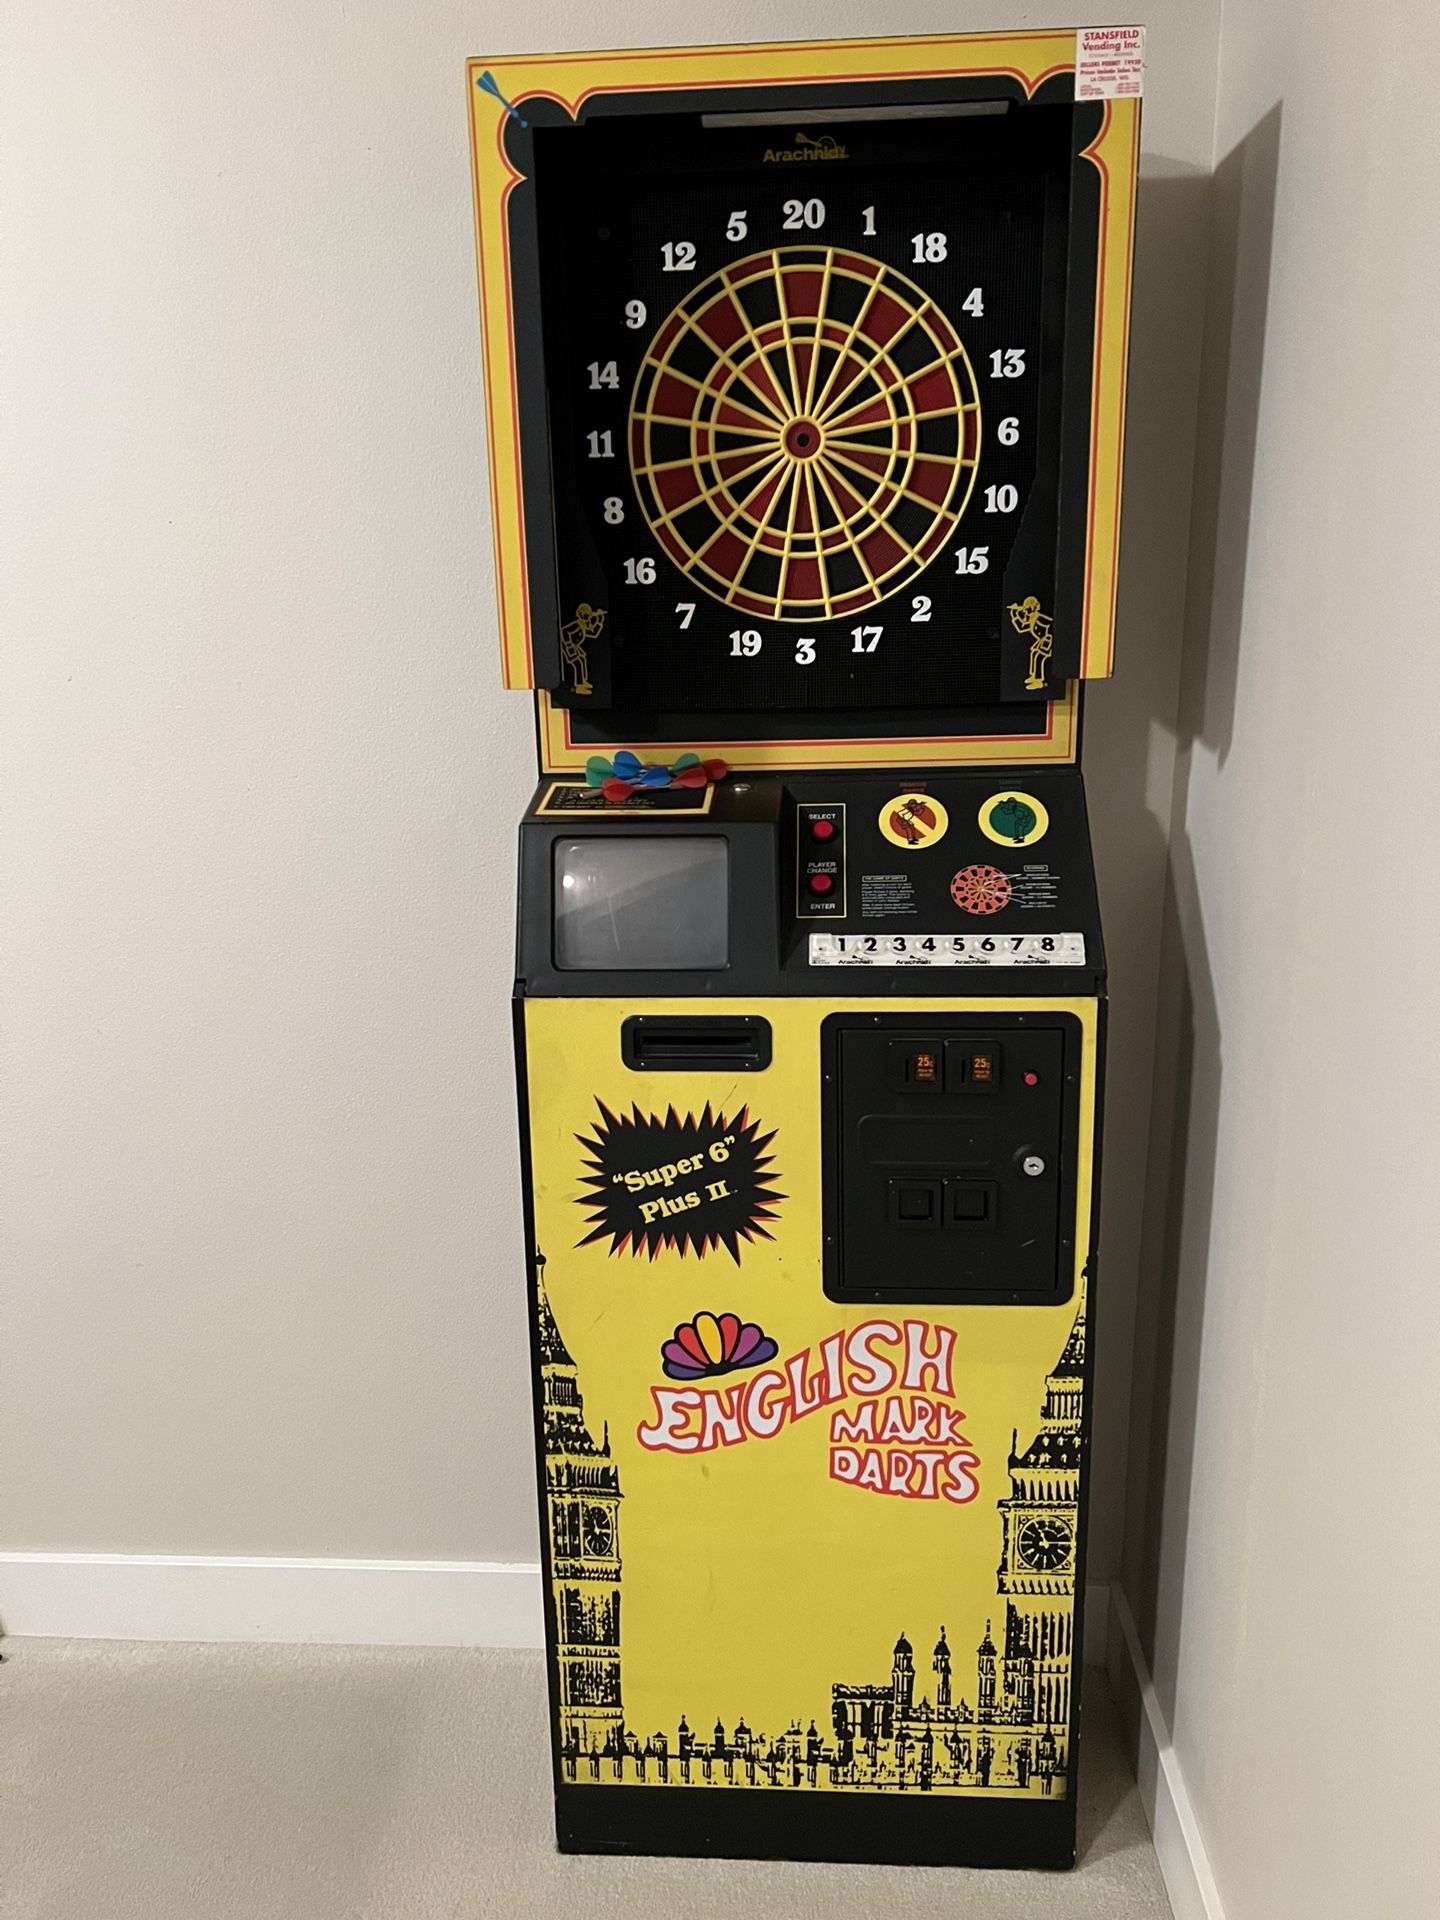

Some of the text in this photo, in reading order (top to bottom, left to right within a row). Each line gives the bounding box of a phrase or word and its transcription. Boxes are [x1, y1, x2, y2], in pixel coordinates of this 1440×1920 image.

[1082, 40, 1141, 51] Vending Inc.
[1084, 30, 1139, 41] STANSFIELD
[763, 145, 846, 162] Arachnid
[726, 211, 748, 241] 5
[783, 198, 826, 229] 20
[862, 206, 877, 235] 1
[661, 241, 697, 272] 12
[911, 232, 948, 263] 18
[625, 300, 647, 329] 9
[962, 287, 985, 317] 4
[587, 361, 620, 390] 14
[989, 349, 1026, 378] 13
[586, 431, 615, 458] 11
[997, 417, 1020, 446] 6
[603, 497, 625, 525] 8
[984, 485, 1019, 513] 10
[623, 557, 657, 585] 16
[955, 546, 990, 575] 15
[675, 603, 697, 630] 7
[910, 595, 932, 622] 2
[729, 629, 763, 657] 19
[794, 638, 817, 665] 3
[851, 626, 884, 653] 17
[838, 937, 1055, 952] 1 2 3 4 5 6 7 8
[612, 1135, 736, 1193] “Super 6”
[638, 1180, 731, 1224] Plus II
[637, 1319, 958, 1453] ENGLISH
[829, 1396, 973, 1447] MARK
[828, 1446, 981, 1505] DARTS
